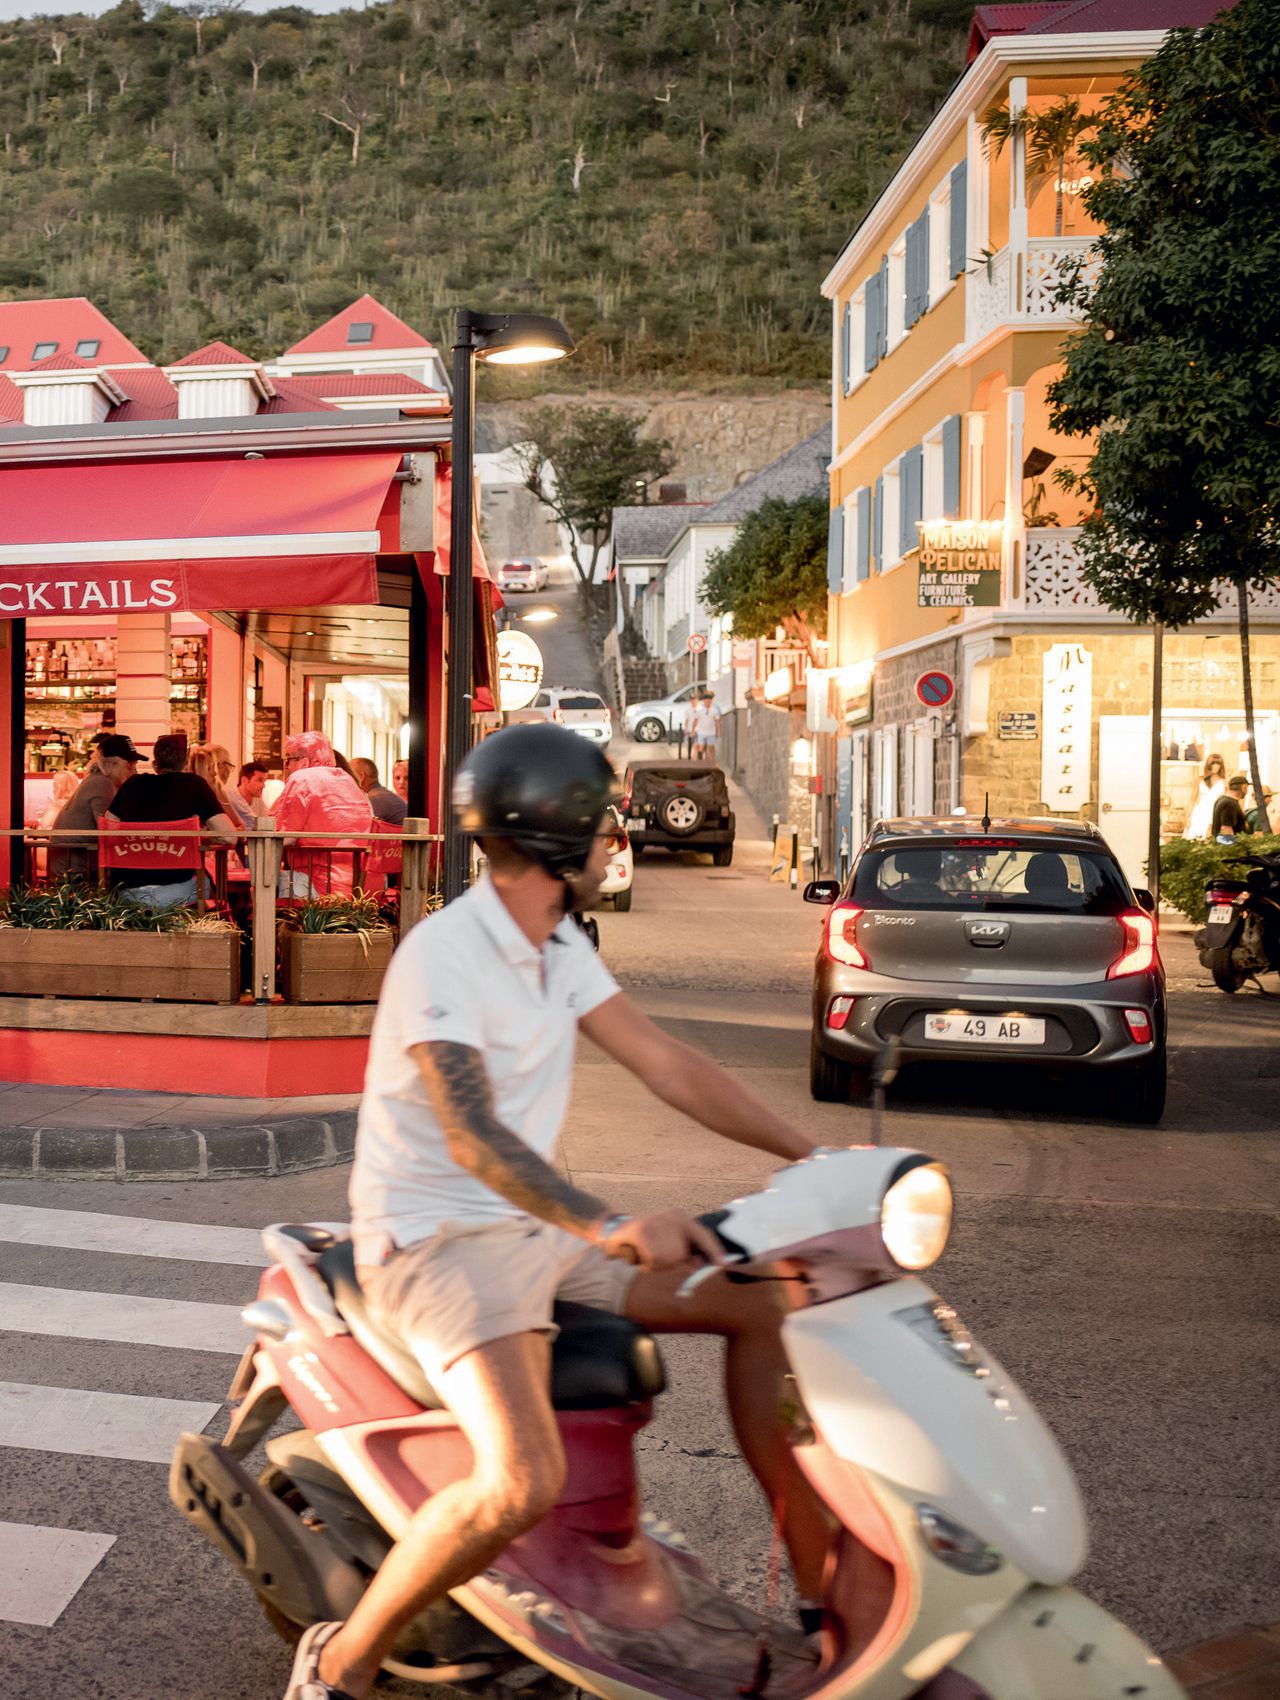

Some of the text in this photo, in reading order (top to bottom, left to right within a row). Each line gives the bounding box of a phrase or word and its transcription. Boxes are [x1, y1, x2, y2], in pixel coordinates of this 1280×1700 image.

[923, 525, 989, 551] MAISON
[920, 549, 1001, 571] PELICAN
[919, 573, 981, 585] ART GALLERY
[919, 584, 968, 596] FURNITURE
[930, 595, 975, 607] CERAMICS
[114, 842, 187, 857] L'OUBLI
[963, 1020, 1021, 1039] 49 AB
